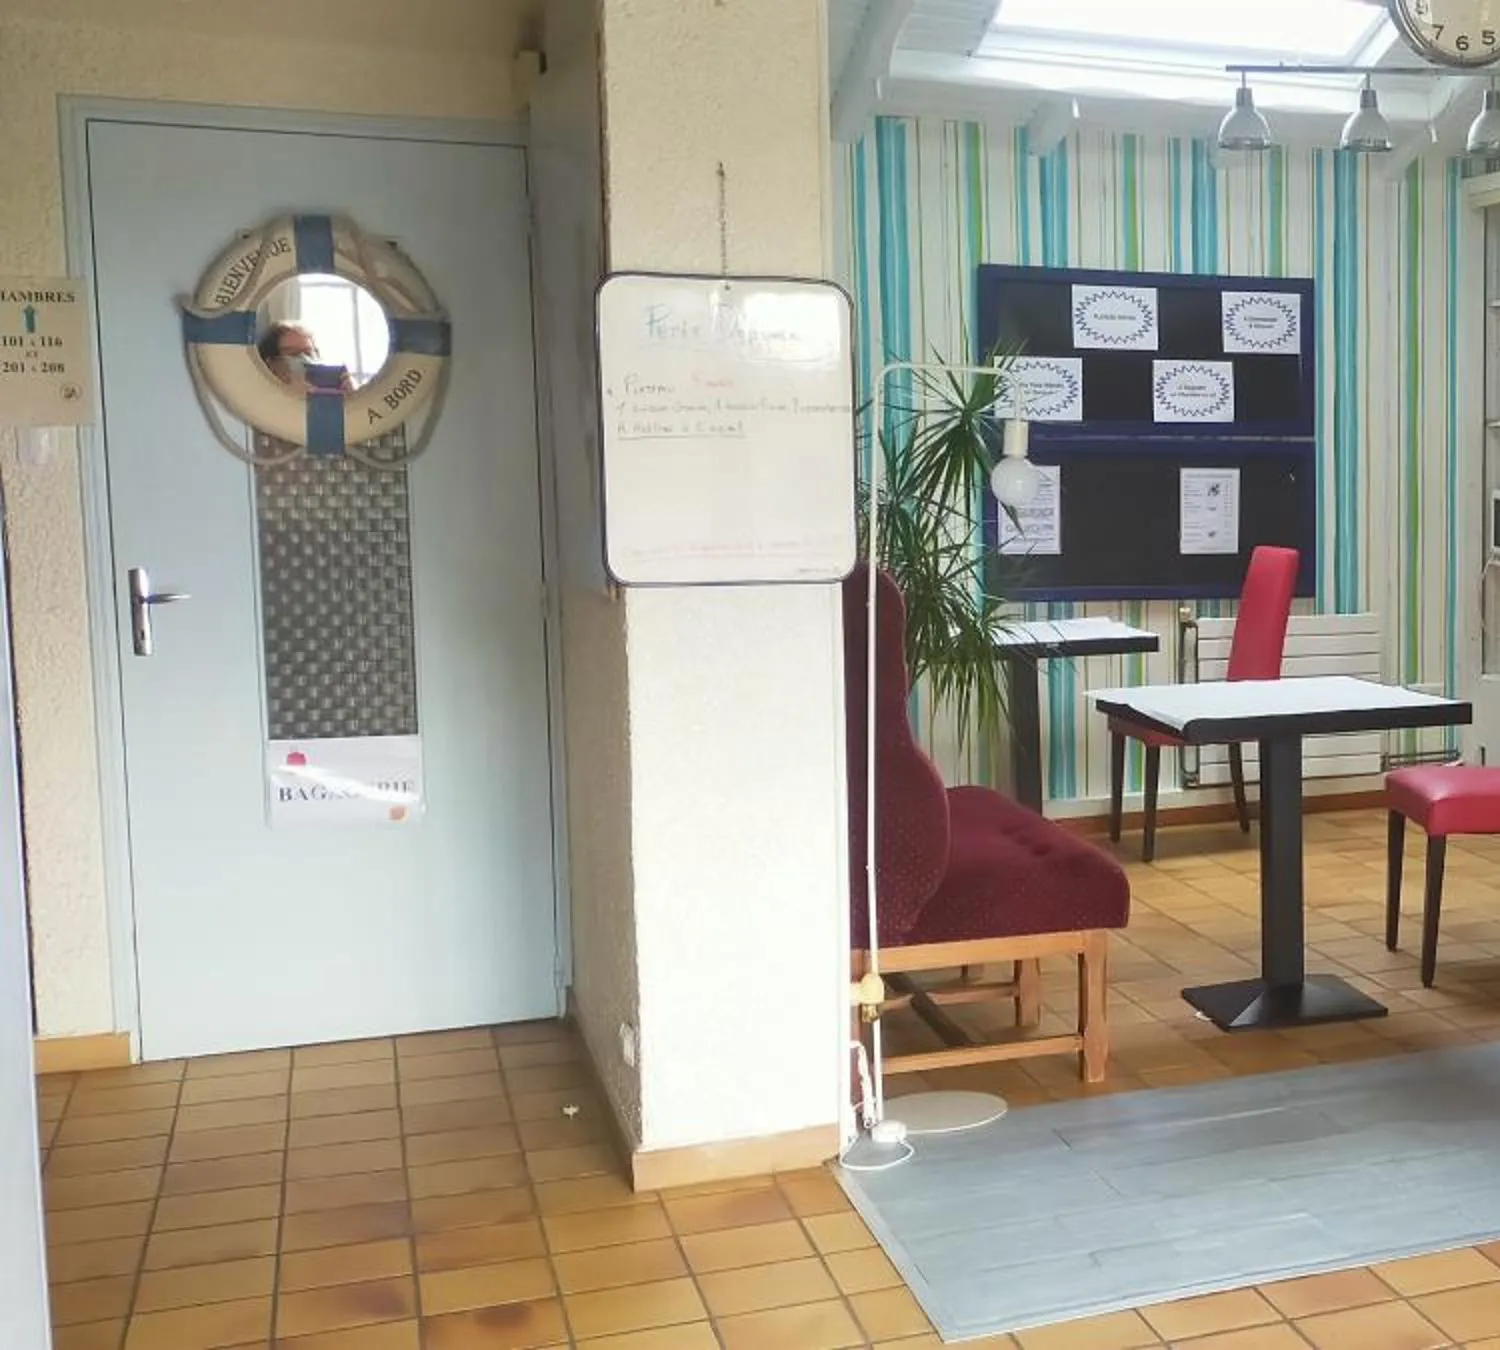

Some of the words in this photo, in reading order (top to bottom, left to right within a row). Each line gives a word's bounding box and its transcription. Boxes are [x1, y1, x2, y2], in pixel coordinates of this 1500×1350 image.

[1432, 24, 1444, 40] 7
[1482, 30, 1496, 45] 5
[1455, 35, 1469, 51] 6
[2, 336, 23, 347] 101
[2, 361, 25, 373] 201
[367, 407, 383, 425] A
[383, 369, 422, 411] BORD
